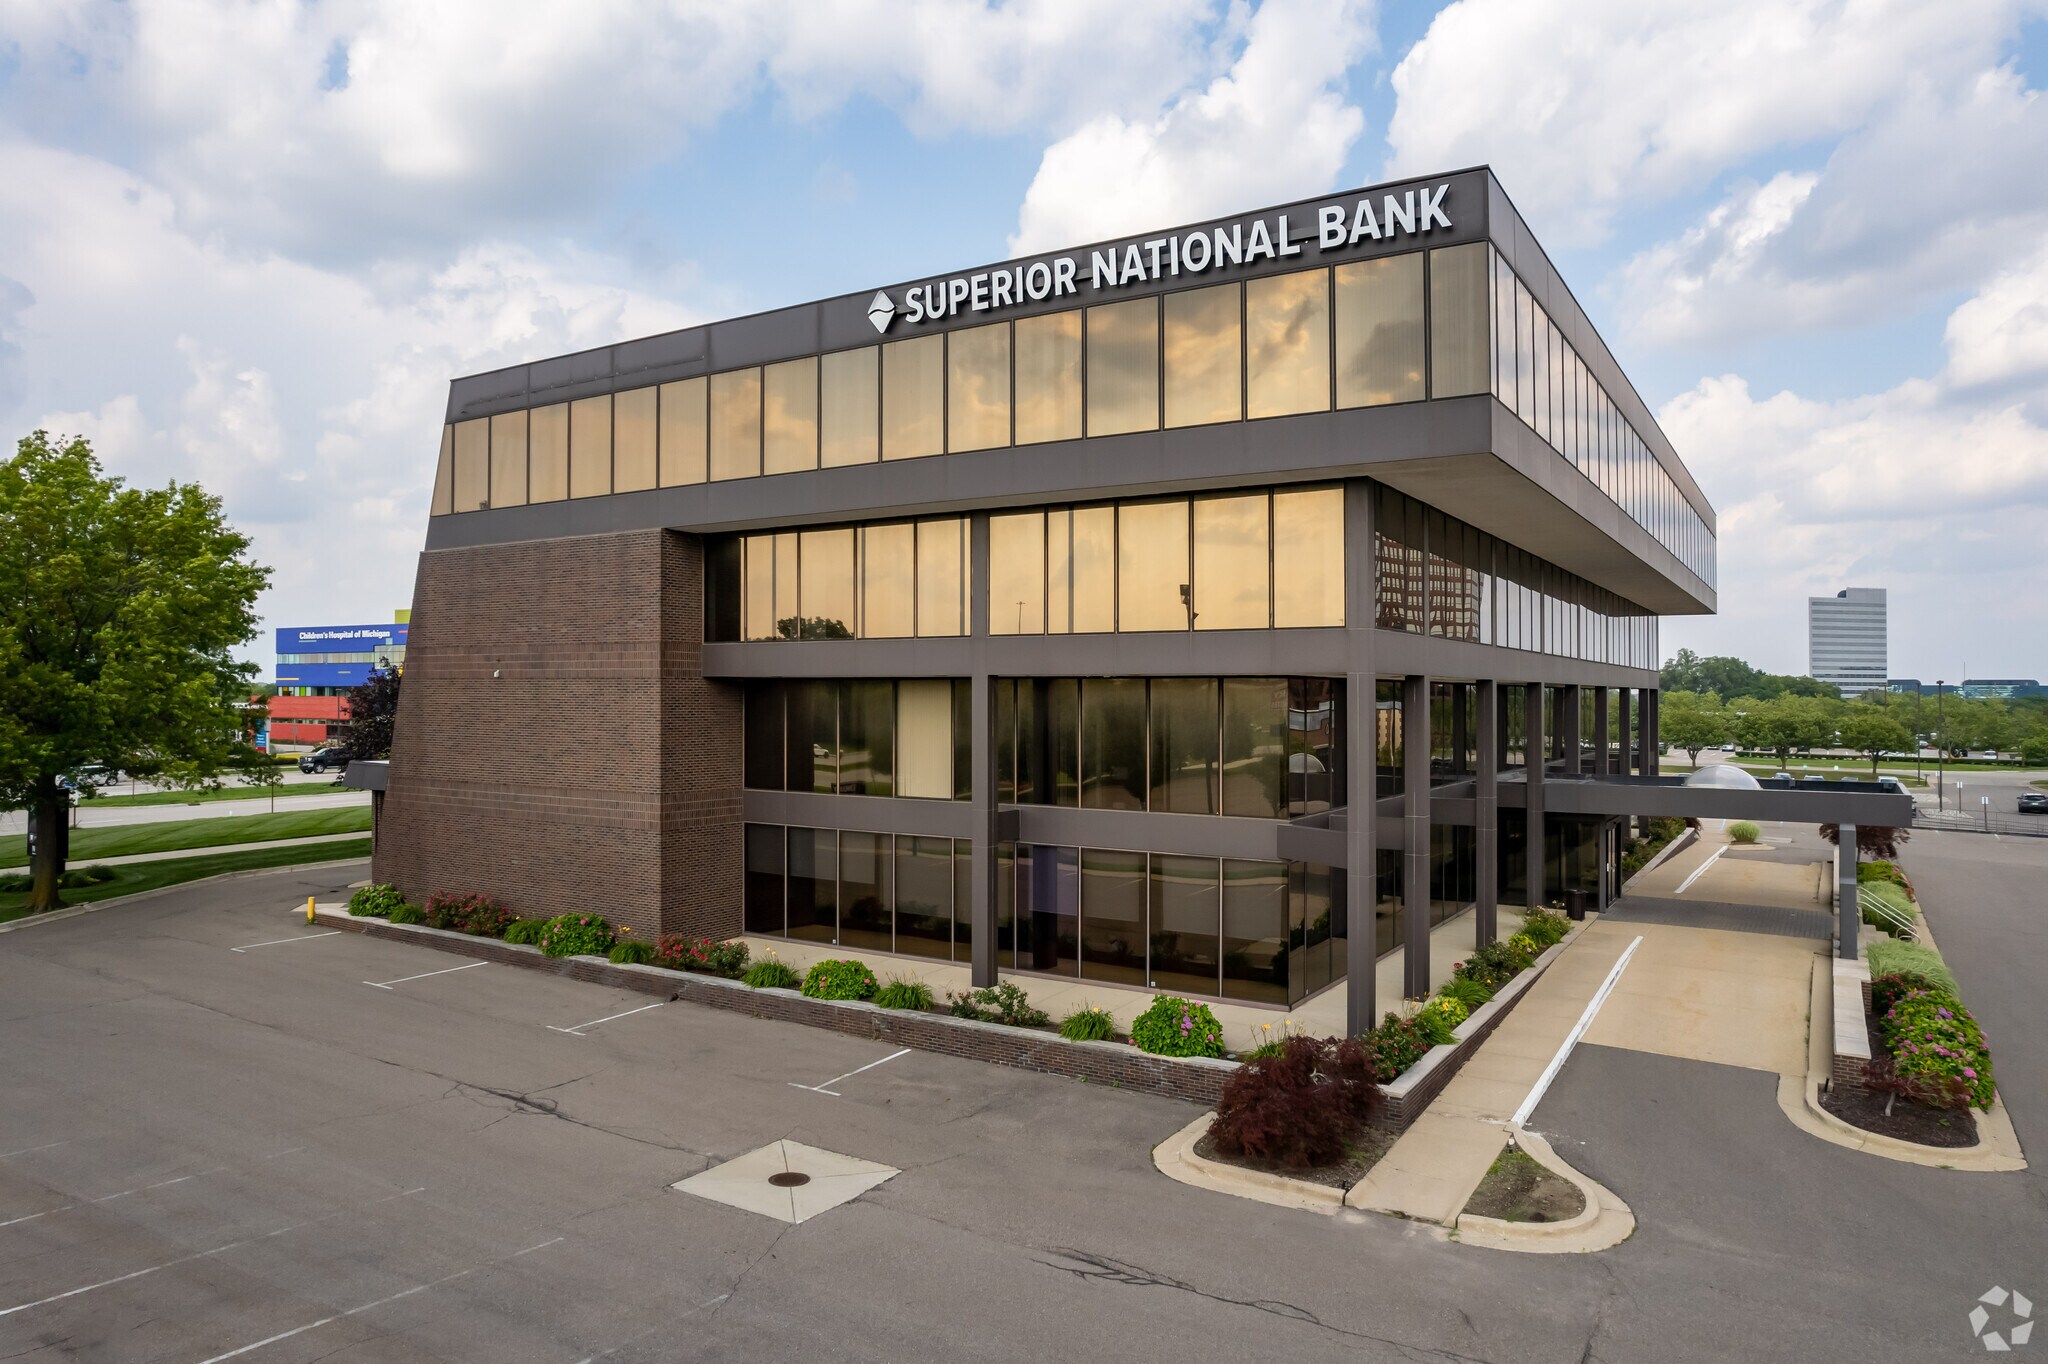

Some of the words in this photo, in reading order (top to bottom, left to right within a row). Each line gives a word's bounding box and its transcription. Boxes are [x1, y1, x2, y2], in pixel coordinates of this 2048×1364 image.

[904, 257, 1077, 324] SUPERIOR
[1092, 215, 1300, 289] NATIONAL
[1318, 184, 1453, 249] BANK
[299, 631, 328, 640] Children's
[328, 630, 353, 640] Hospital
[353, 630, 361, 638] of
[361, 629, 391, 639] Michigan
